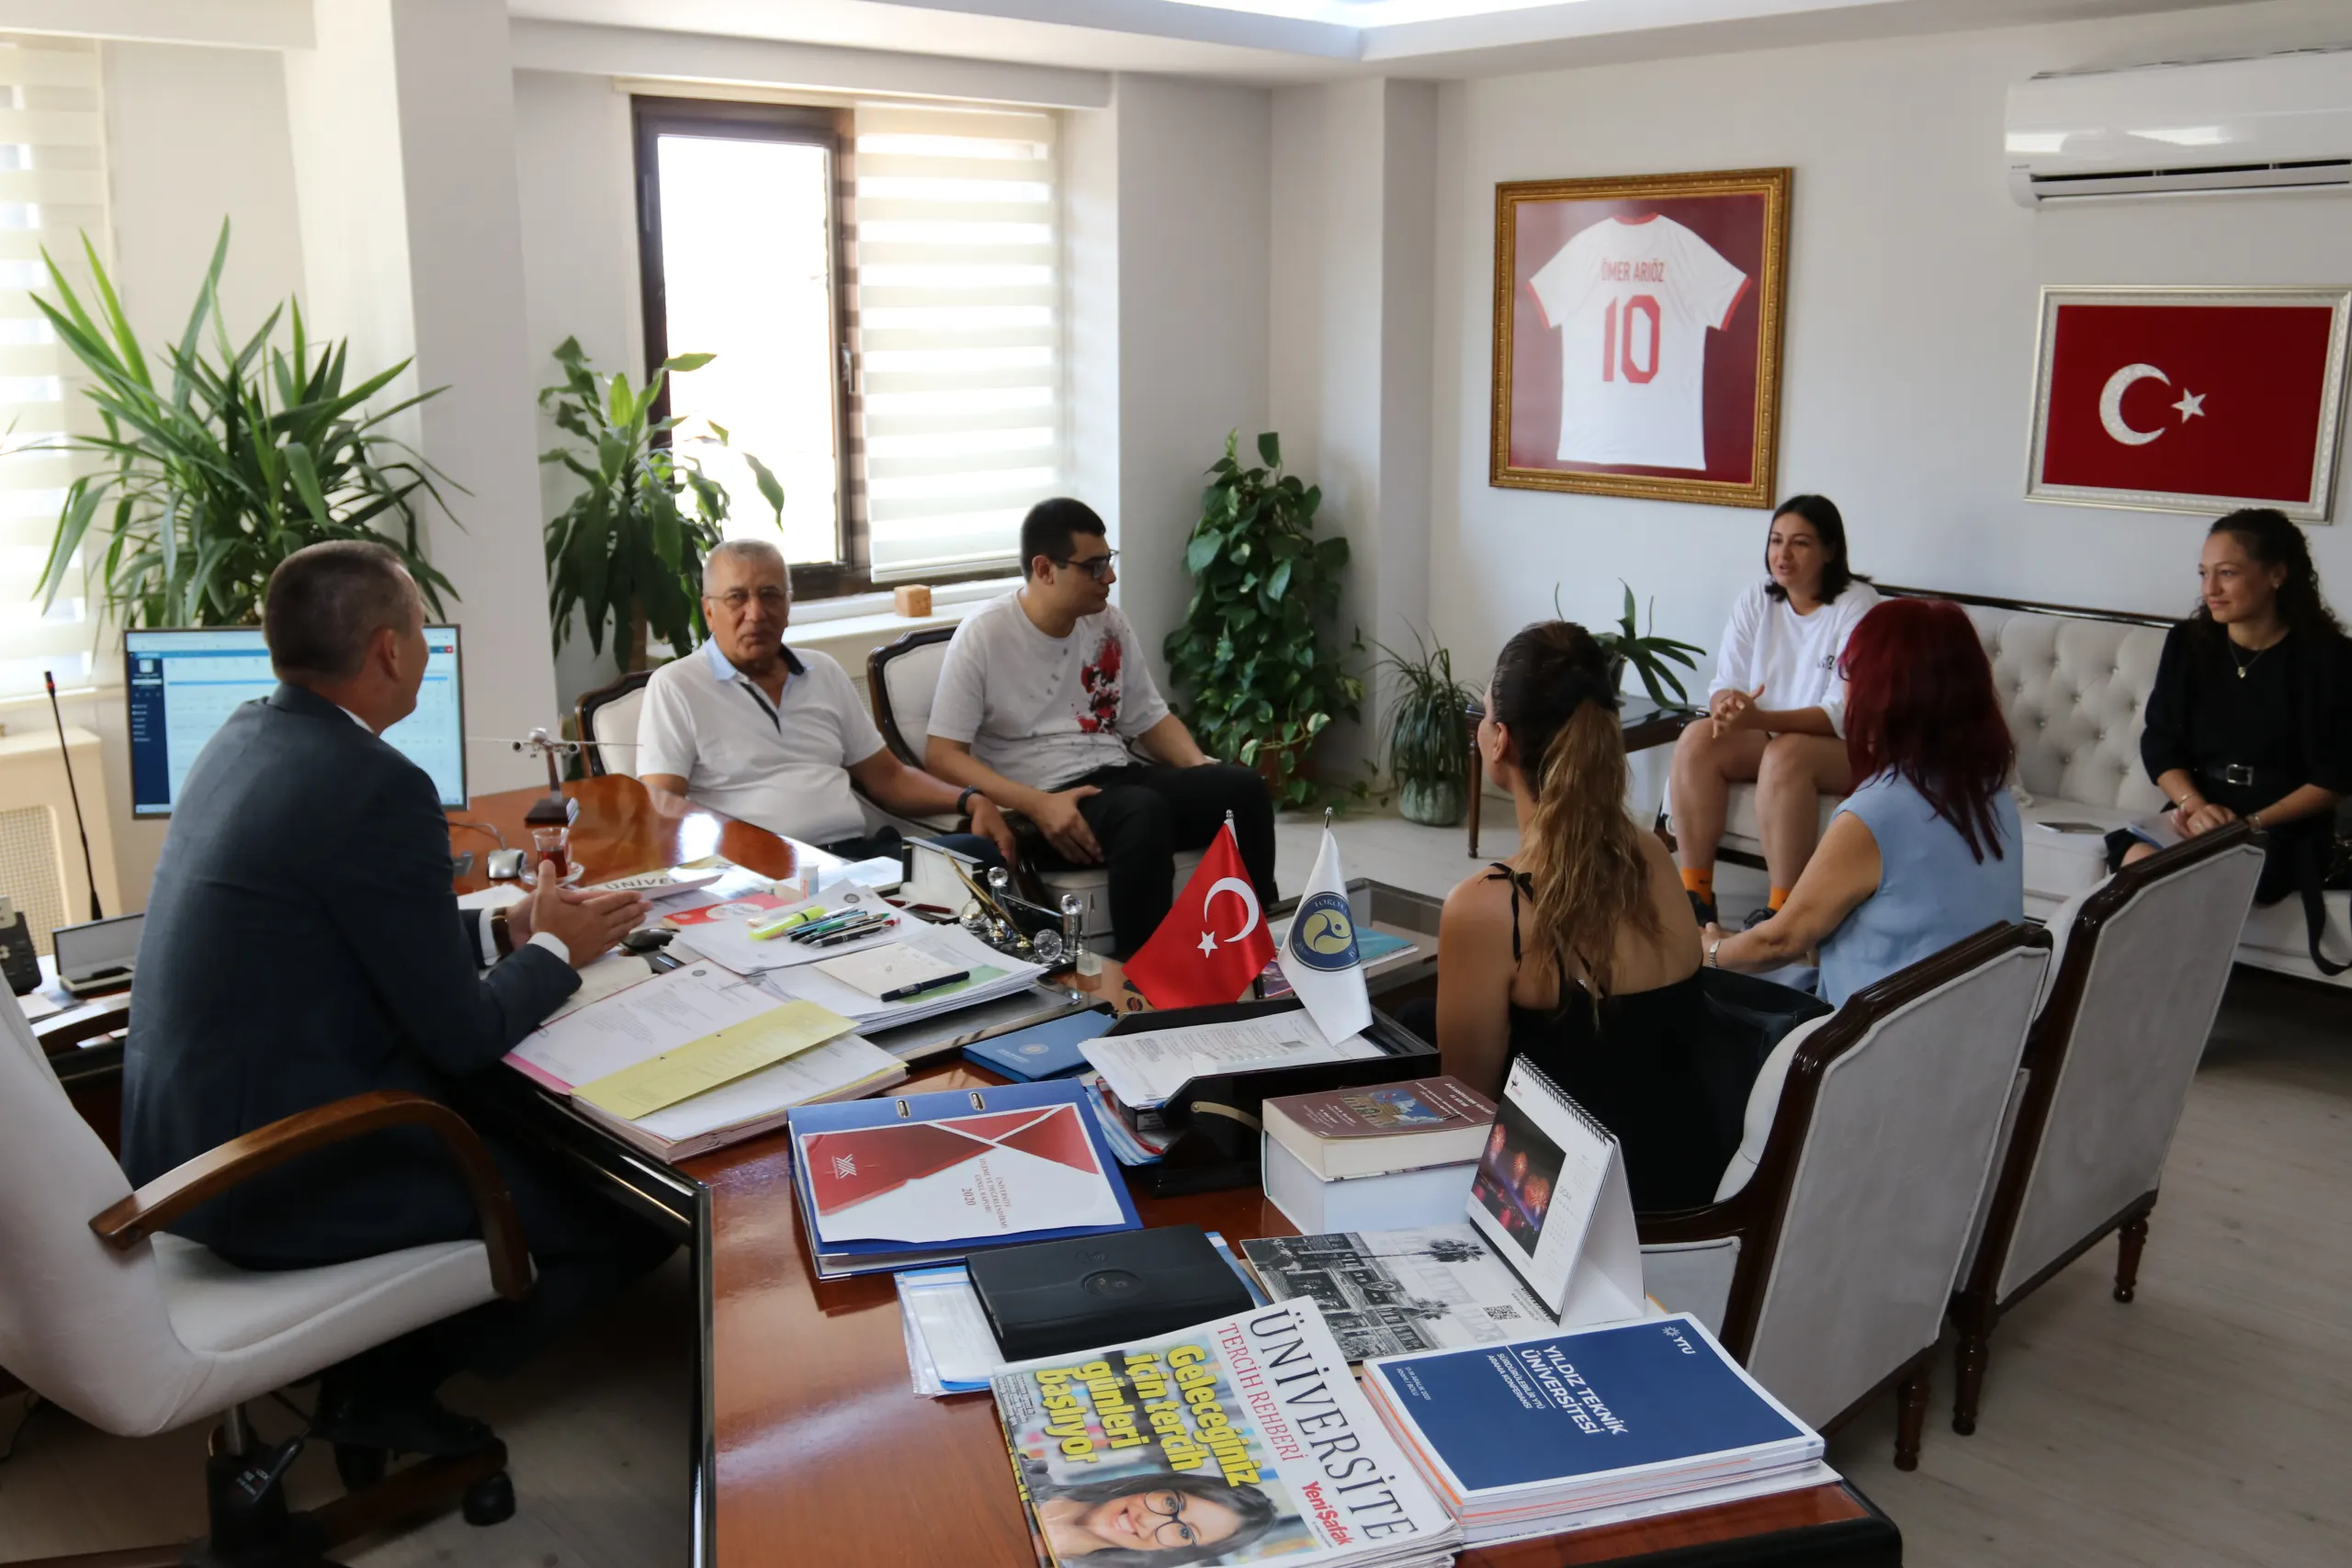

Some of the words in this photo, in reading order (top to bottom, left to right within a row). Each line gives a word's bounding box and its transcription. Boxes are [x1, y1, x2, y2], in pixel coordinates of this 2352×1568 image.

[1601, 257, 1631, 281] ÖMER
[1634, 258, 1665, 282] ARIÖZ
[1602, 294, 1661, 384] 10
[961, 1187, 977, 1206] 2020
[1071, 1360, 1150, 1450] günleri
[1124, 1353, 1169, 1399] için
[1217, 1322, 1264, 1389] TERCİH
[1247, 1390, 1309, 1461] REHBERİ
[1487, 1355, 1507, 1374] ARAMA
[1521, 1348, 1605, 1435] ÜNİVERSİTESİ
[1544, 1345, 1587, 1387] YILDIZ
[1577, 1387, 1629, 1435] TEKNİK
[1035, 1368, 1100, 1463] başlıyor
[1144, 1400, 1210, 1472] tercih
[1167, 1344, 1262, 1487] Geleceğiniz
[1250, 1308, 1419, 1540] ÜNİVERSİTE
